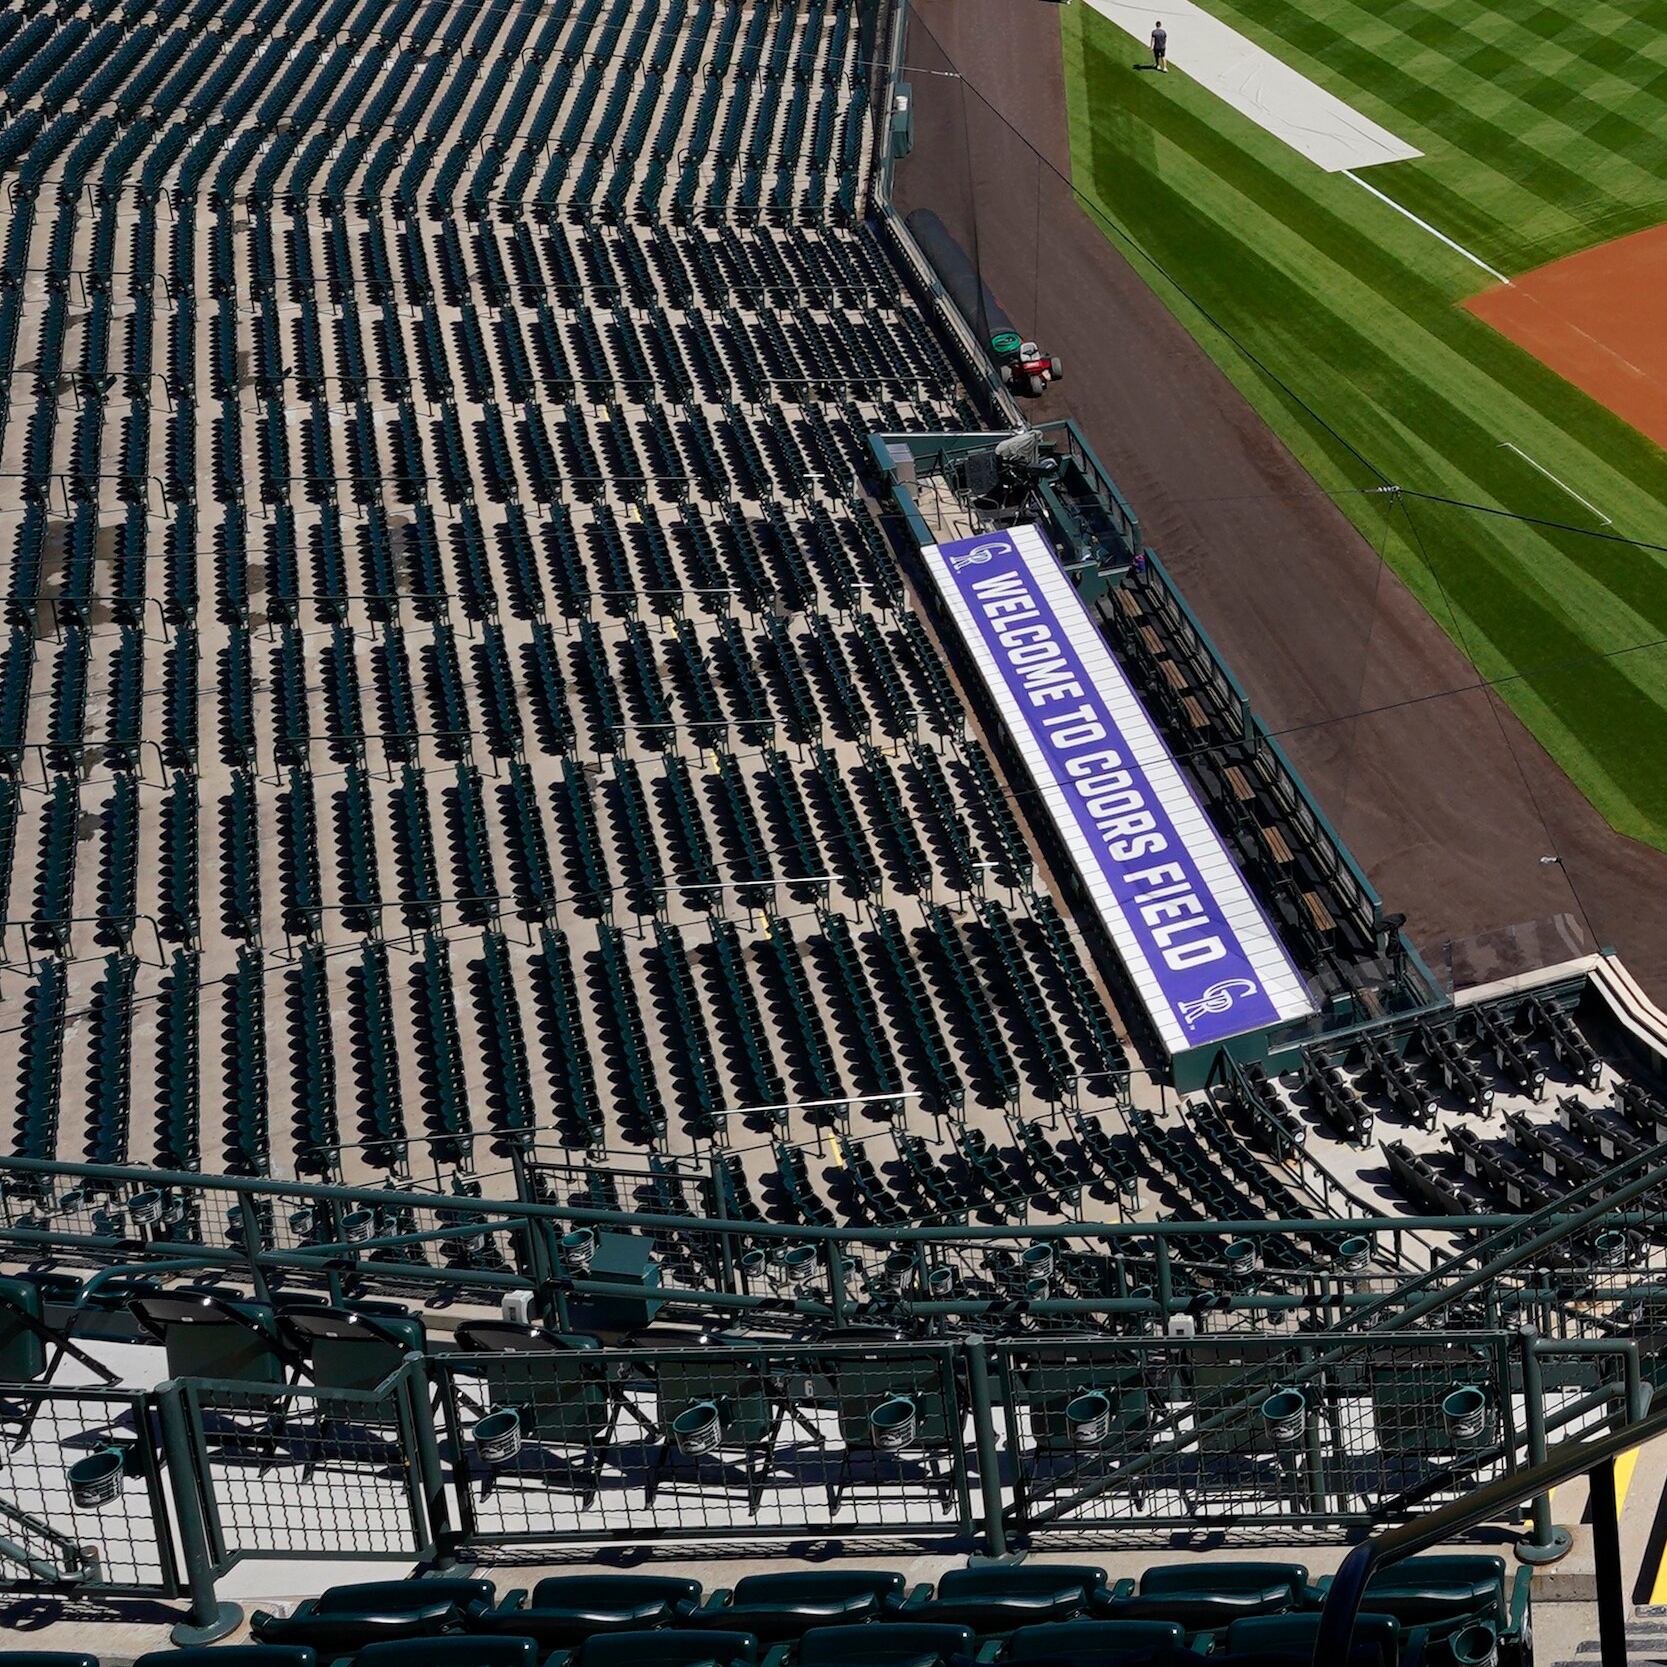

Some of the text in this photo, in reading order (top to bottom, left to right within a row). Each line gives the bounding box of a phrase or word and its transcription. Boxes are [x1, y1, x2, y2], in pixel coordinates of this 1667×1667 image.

[971, 570, 1228, 973] WELCOME TO COORS FIELD
